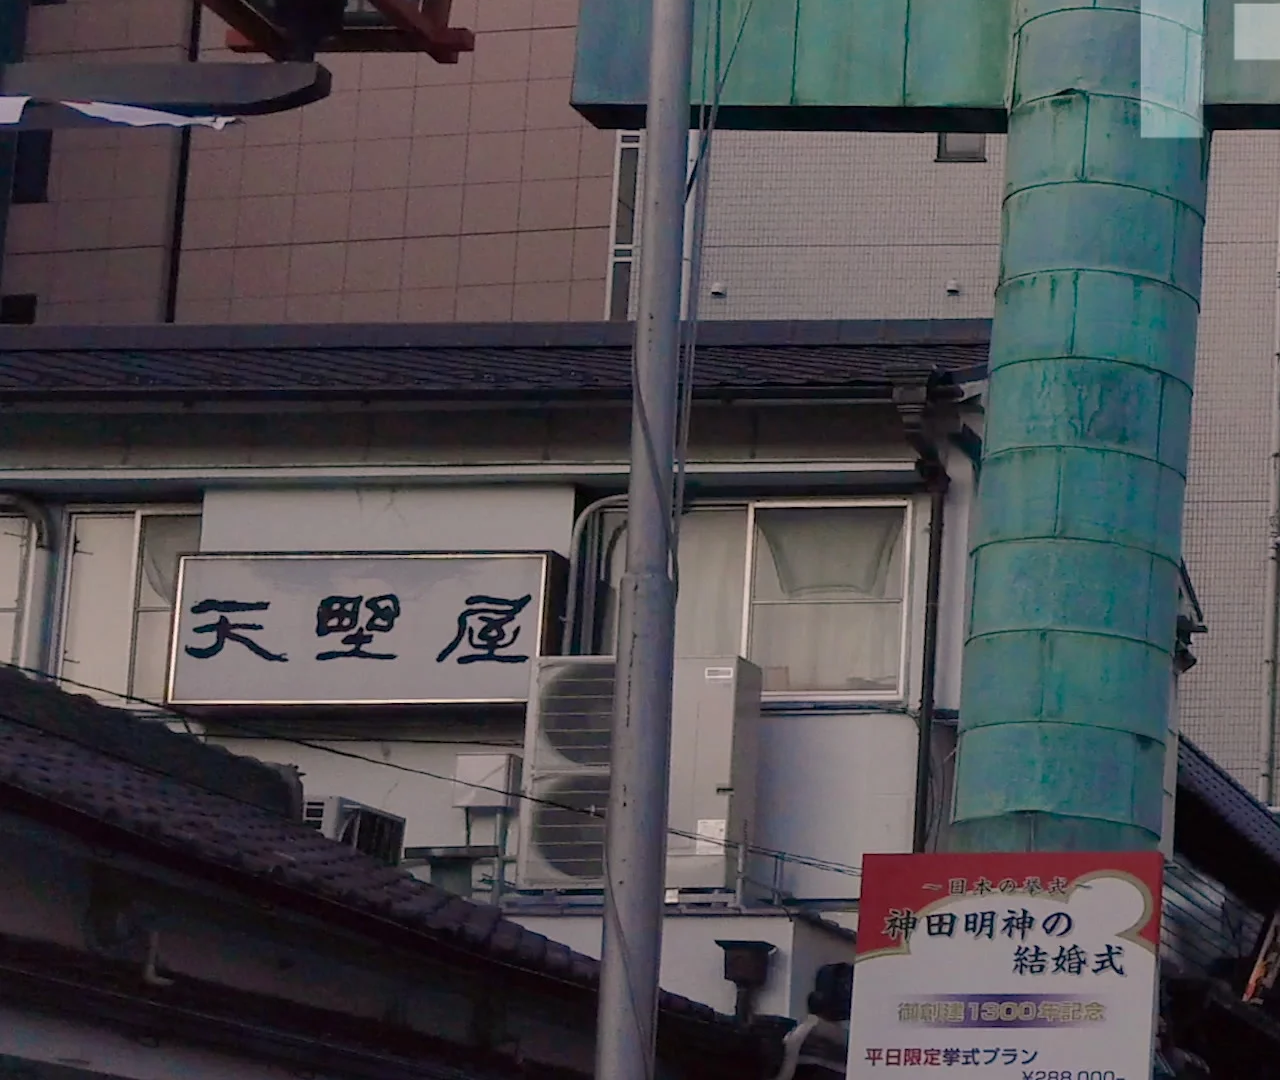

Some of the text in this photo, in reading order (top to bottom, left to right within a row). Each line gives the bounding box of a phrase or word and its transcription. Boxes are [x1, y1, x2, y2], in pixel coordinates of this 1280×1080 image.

[882, 909, 1073, 941] 神田明神の
[1012, 944, 1126, 976] 結婚式
[865, 1048, 1038, 1066] 平日限定挙式プラン
[1022, 1071, 1126, 1080] ¥288000-
